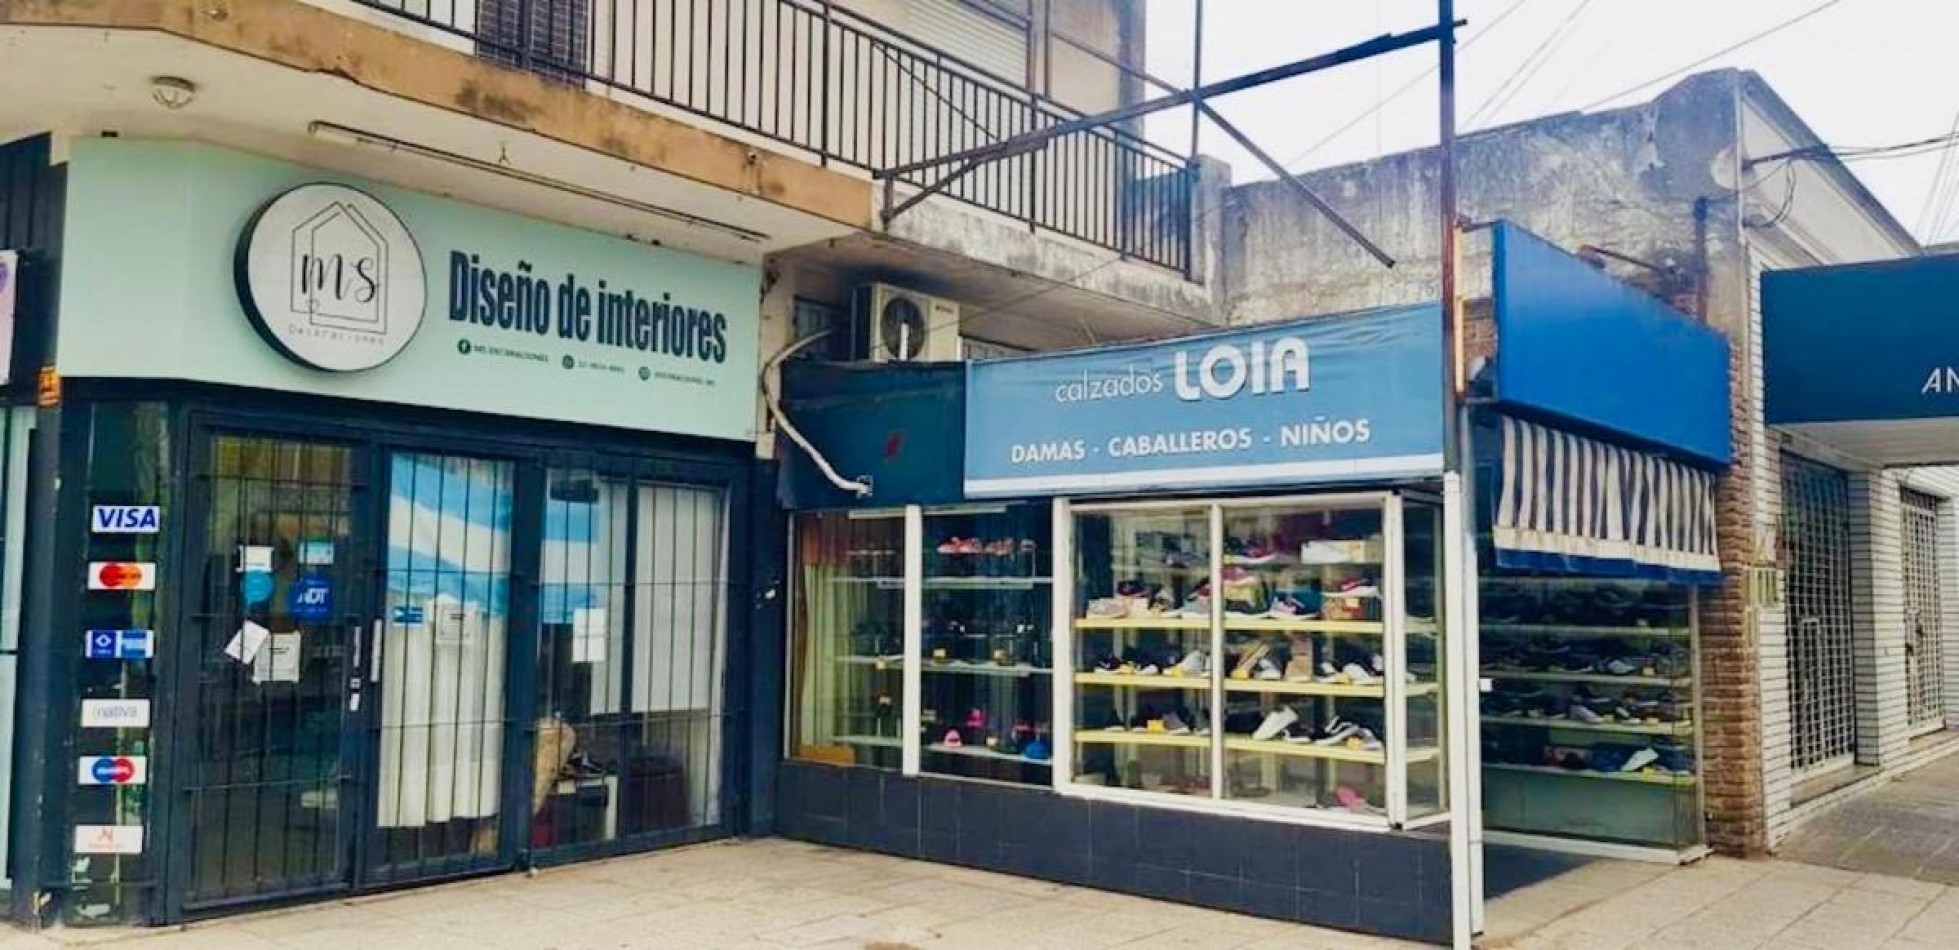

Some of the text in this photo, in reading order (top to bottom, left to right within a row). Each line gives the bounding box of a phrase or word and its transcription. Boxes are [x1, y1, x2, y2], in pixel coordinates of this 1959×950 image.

[449, 250, 728, 364] Diseño de interiores
[1055, 336, 1311, 404] calzados LOIA
[1011, 440, 1086, 464] DAMAS
[1108, 427, 1253, 458] CABALLEROS
[1280, 412, 1371, 448] NIÑOS
[98, 508, 156, 528] VISA
